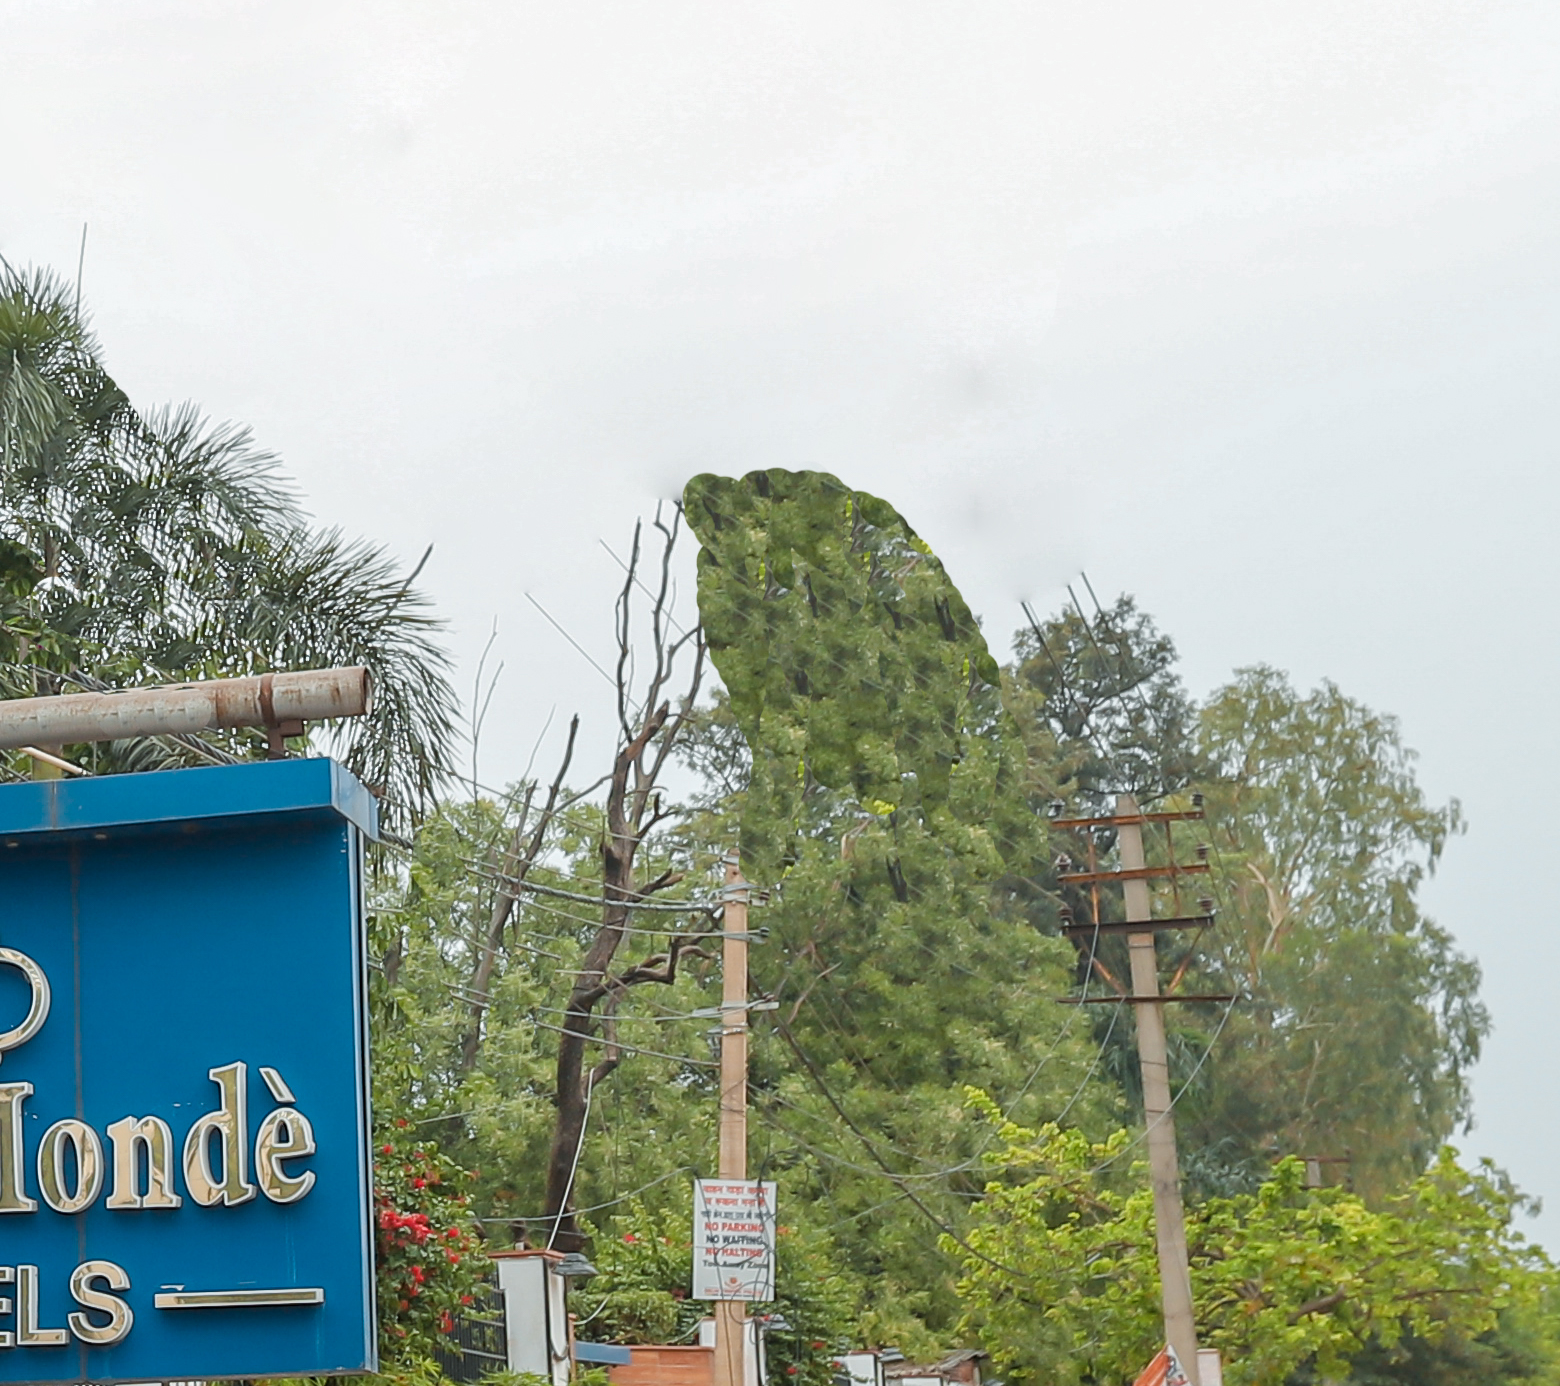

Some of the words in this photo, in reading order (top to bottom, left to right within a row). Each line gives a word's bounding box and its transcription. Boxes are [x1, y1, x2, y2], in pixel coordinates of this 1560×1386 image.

[704, 1222, 719, 1231] NO
[721, 1222, 765, 1232] PARKING
[706, 1234, 720, 1244] NO
[722, 1235, 764, 1245] WAITING
[722, 1247, 764, 1258] HALTING
